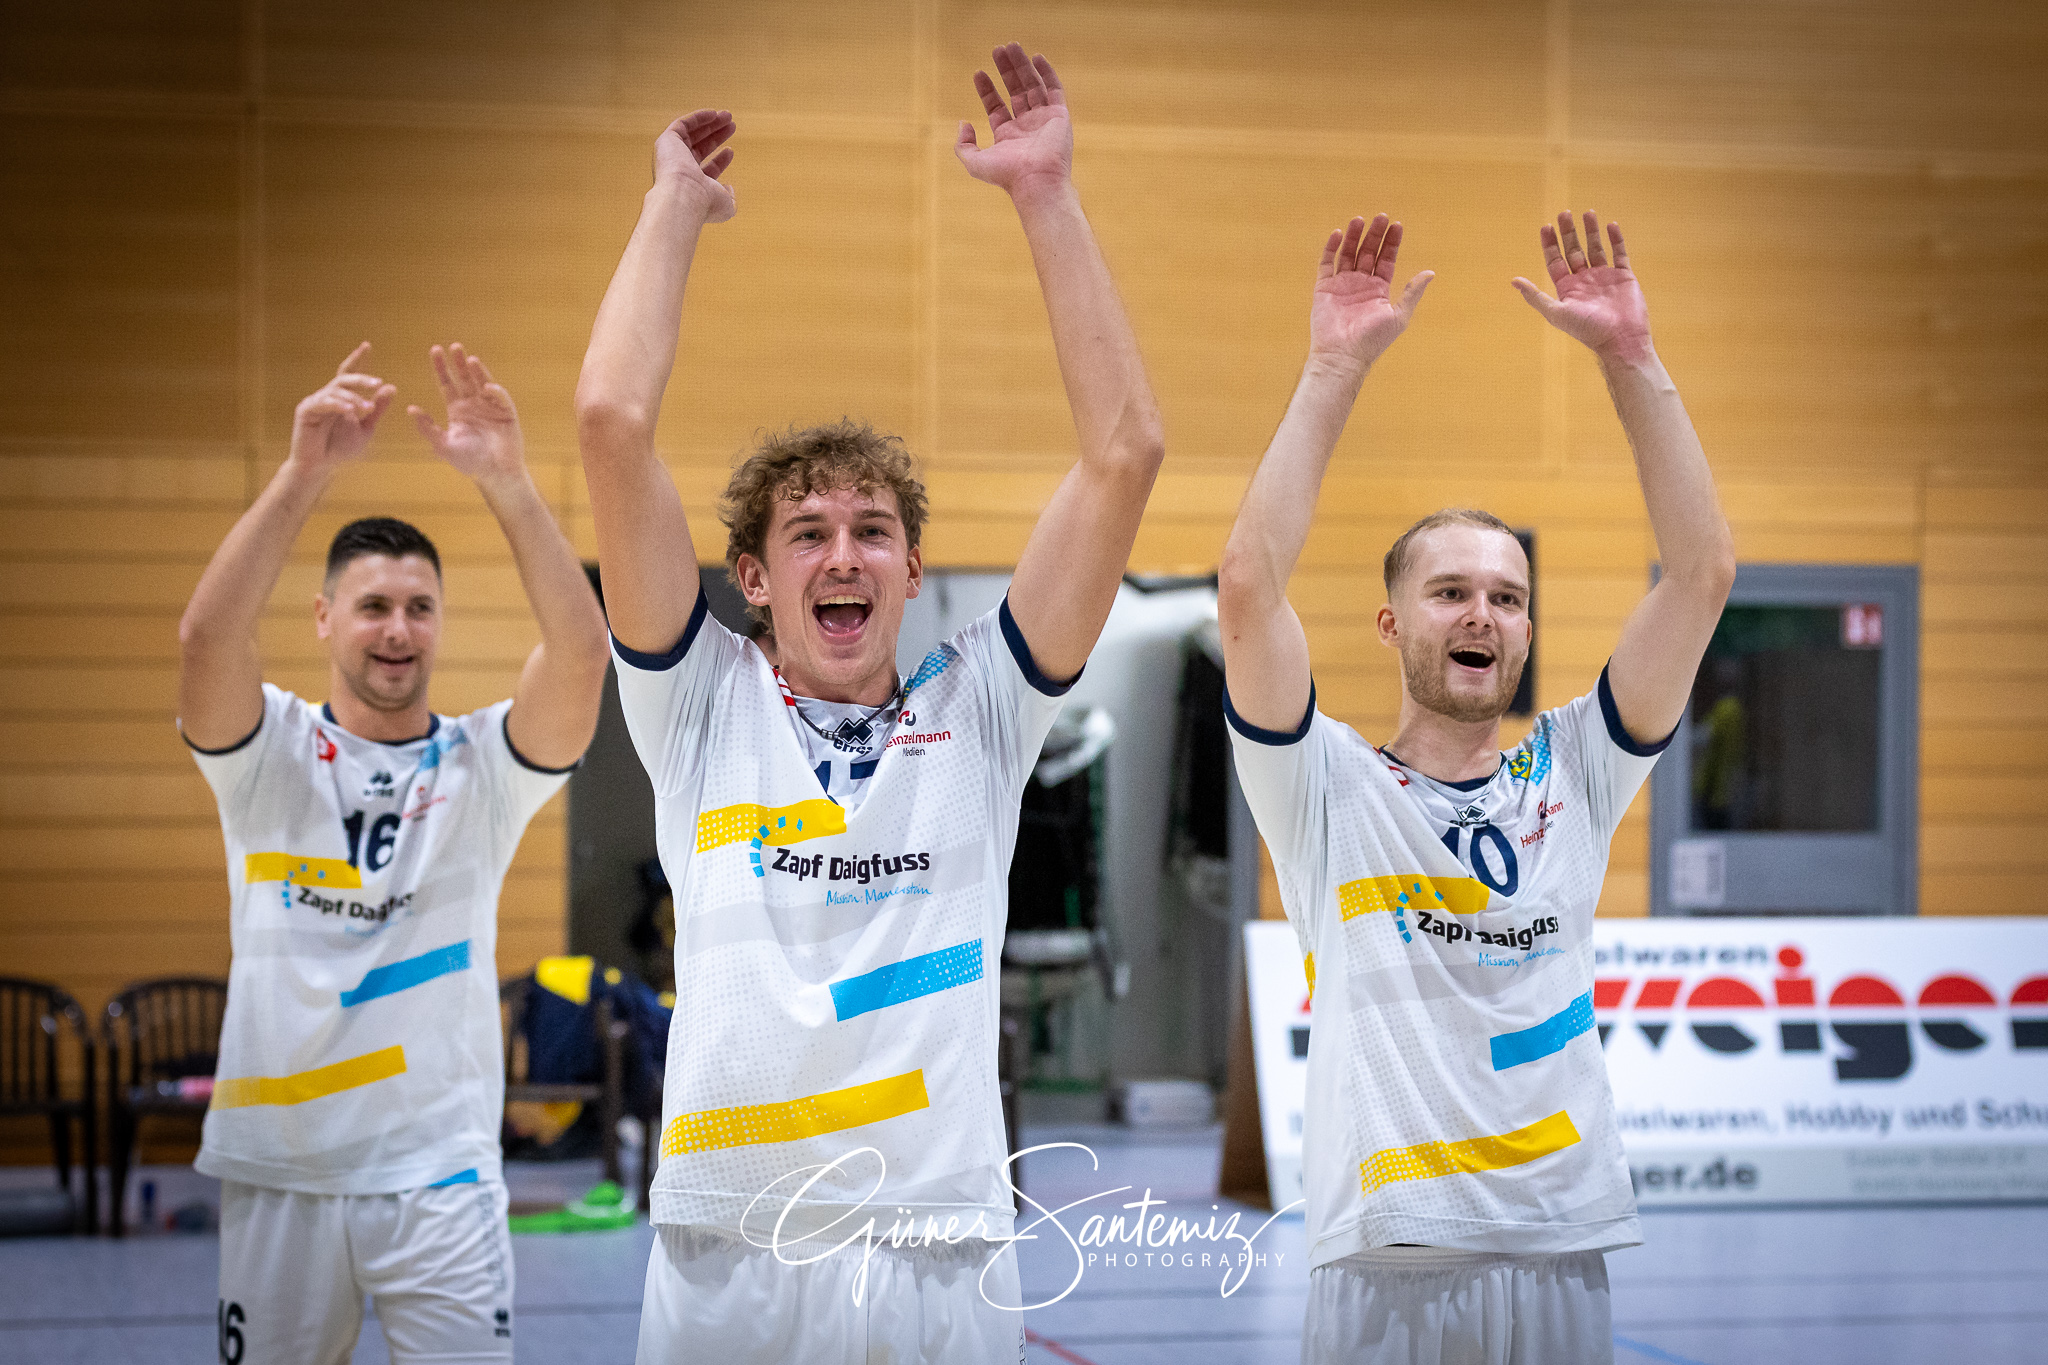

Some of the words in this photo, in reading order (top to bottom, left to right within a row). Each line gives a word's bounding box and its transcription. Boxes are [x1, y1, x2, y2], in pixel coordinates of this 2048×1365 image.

[884, 730, 952, 752] einzelmann
[342, 809, 401, 873] 16
[772, 848, 824, 881] Zapf
[828, 851, 930, 884] Daigfuss
